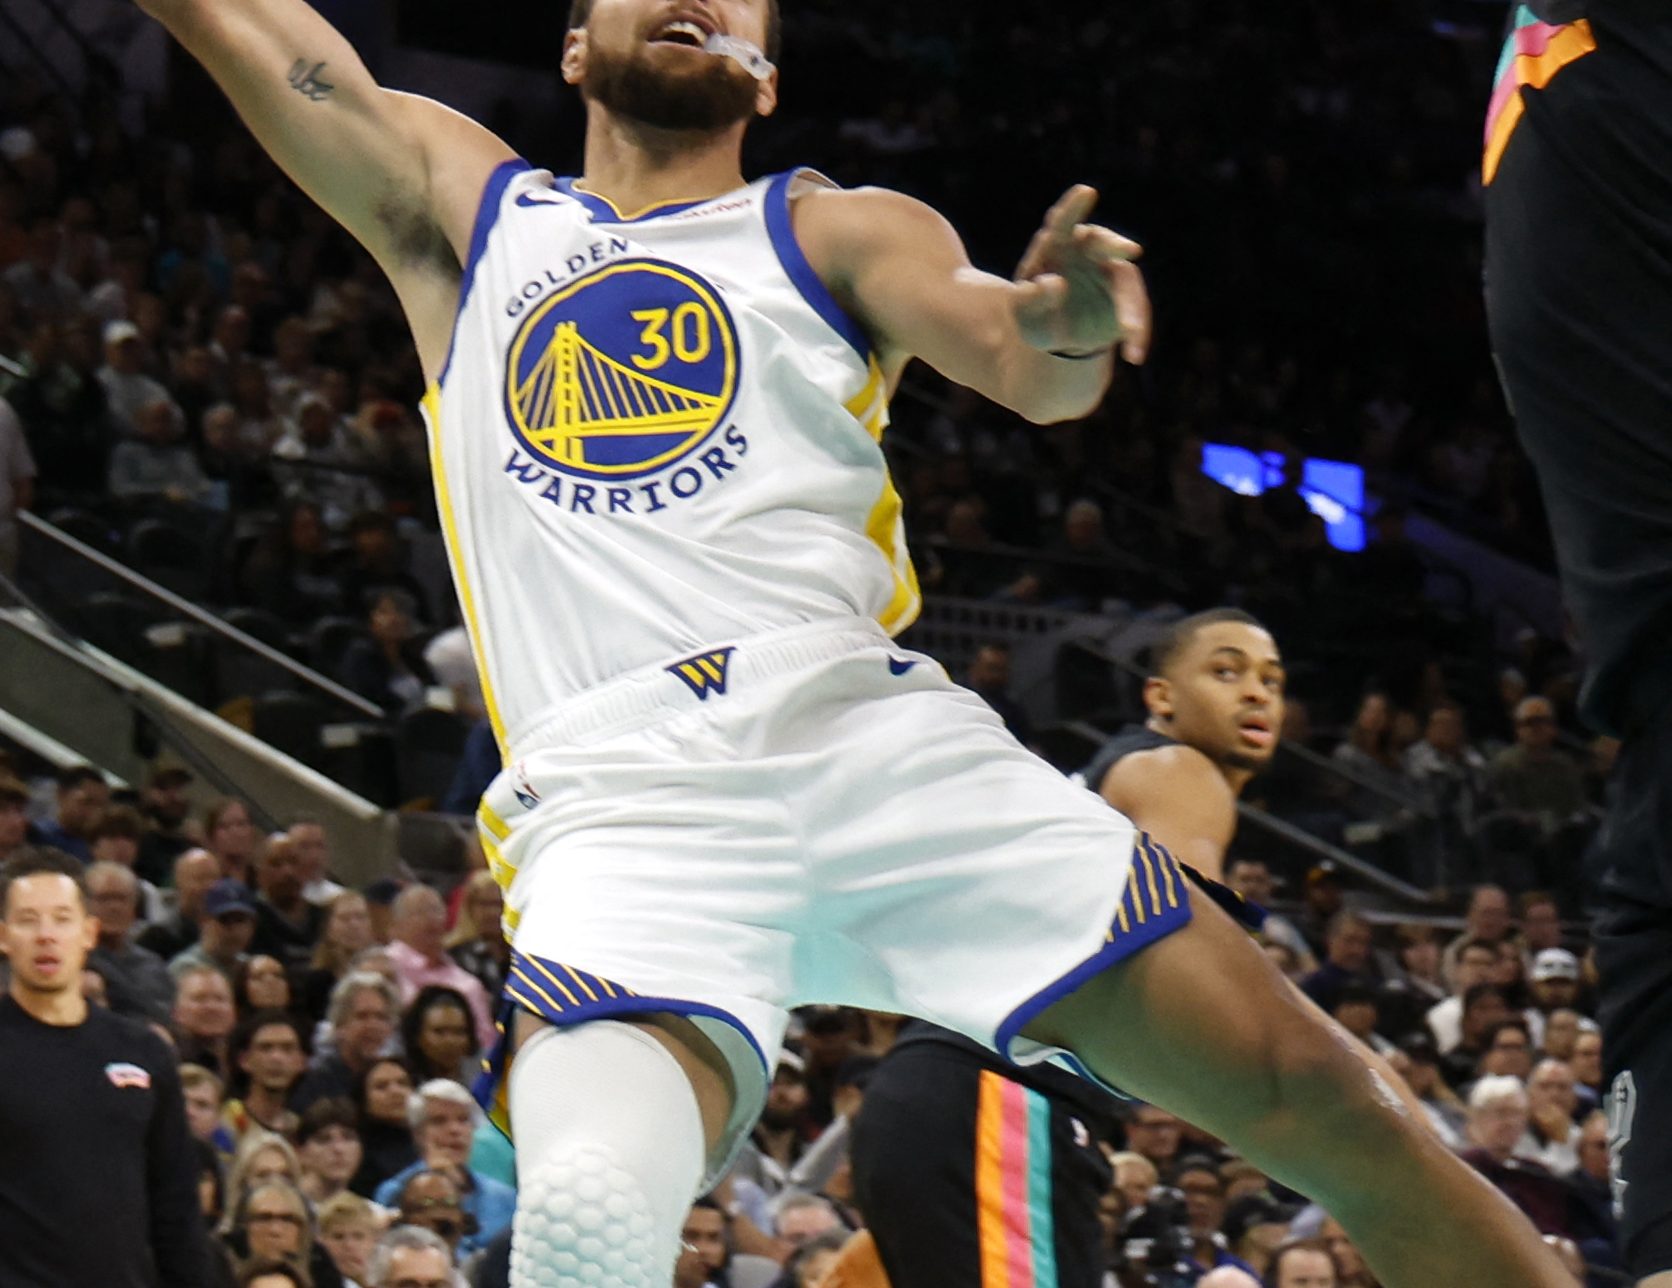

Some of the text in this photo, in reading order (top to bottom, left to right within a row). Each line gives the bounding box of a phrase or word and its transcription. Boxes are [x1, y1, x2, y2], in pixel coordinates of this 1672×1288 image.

[505, 237, 629, 318] GOLDEN
[630, 301, 713, 370] 30
[503, 423, 749, 515] WARRIORS
